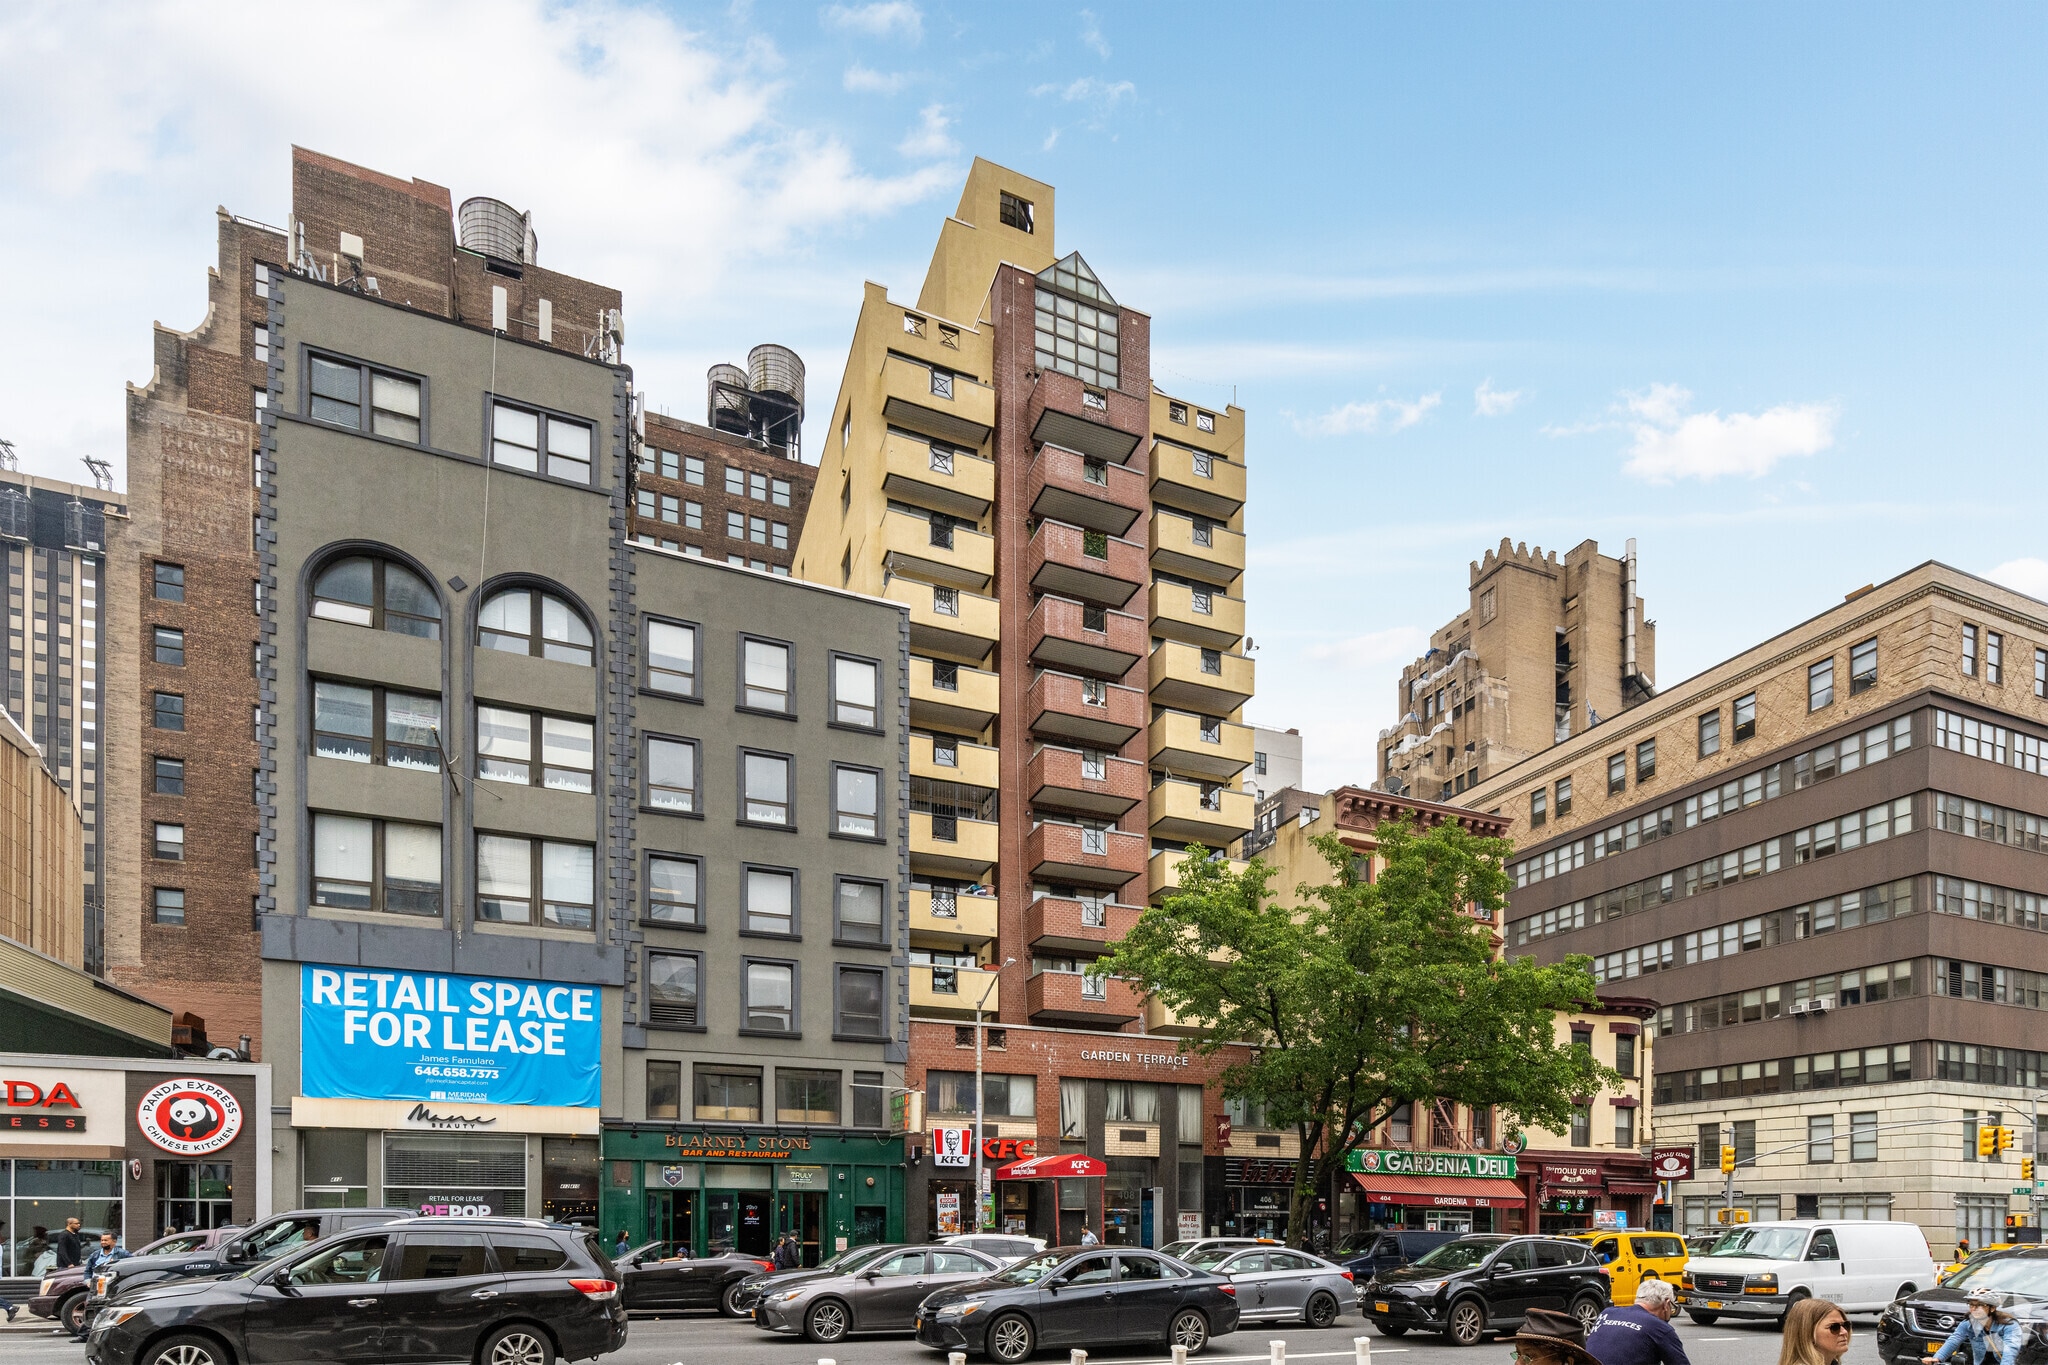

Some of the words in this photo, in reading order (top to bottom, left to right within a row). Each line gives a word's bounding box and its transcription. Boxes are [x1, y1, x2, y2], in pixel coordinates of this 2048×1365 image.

[312, 969, 460, 1013] RETAIL
[469, 981, 594, 1022] SPACE
[344, 1009, 432, 1049] FOR
[443, 1016, 566, 1056] LEASE
[419, 1054, 449, 1063] James
[452, 1055, 495, 1065] Famularo
[1081, 1050, 1130, 1062] GARDEN
[1136, 1053, 1189, 1066] TERRACE
[414, 1066, 499, 1079] 646.658.7373
[3, 1080, 82, 1109] DA
[143, 1083, 182, 1112] PANDA
[187, 1081, 237, 1114] EXPRESS
[11, 1117, 76, 1128] ESS
[147, 1125, 188, 1151] CHINESE
[193, 1127, 234, 1151] KITCHEN
[665, 1134, 747, 1149] BLARNEY
[758, 1137, 812, 1150] STONE
[973, 1138, 1035, 1160] KFC
[940, 1156, 965, 1164] KFC
[1071, 1160, 1090, 1169] KFC
[1385, 1153, 1471, 1174] GARDENIA
[1476, 1156, 1508, 1176] DELI
[790, 1171, 813, 1179] TRULY
[1118, 1190, 1135, 1200] 408
[1434, 1197, 1467, 1206] GARDENIA
[1475, 1198, 1490, 1207] DELI
[1603, 1319, 1642, 1331] SERVICES
